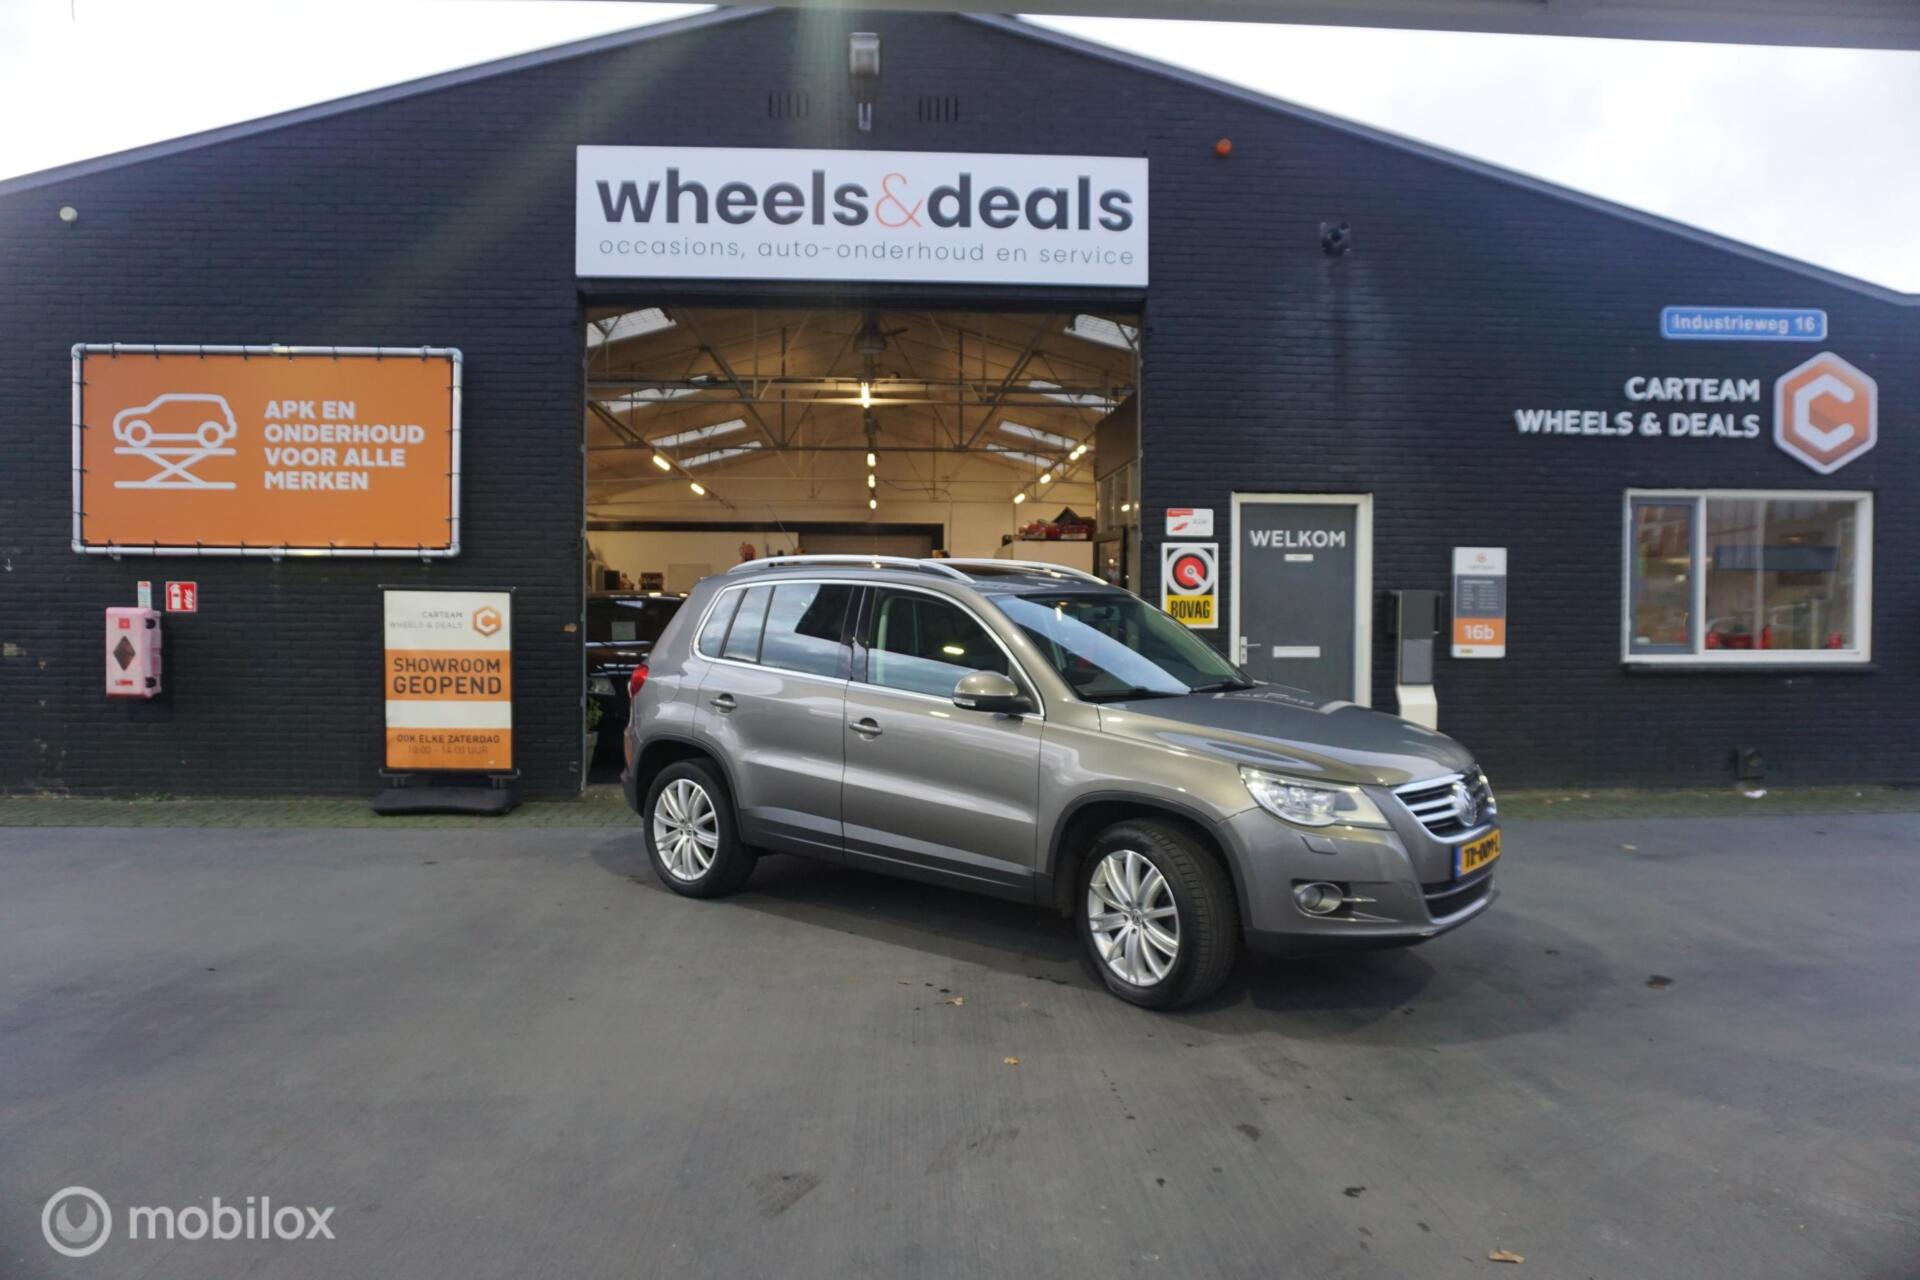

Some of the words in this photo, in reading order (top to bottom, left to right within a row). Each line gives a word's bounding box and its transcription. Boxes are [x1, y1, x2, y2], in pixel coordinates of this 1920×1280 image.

[599, 237, 746, 260] occasions,
[758, 239, 984, 262] auto-onderhoud
[997, 246, 1027, 263] en
[1039, 246, 1134, 266] service
[1674, 314, 1788, 334] Industrieweg
[1795, 317, 1815, 332] 16
[1624, 377, 1760, 402] CARTEAM
[264, 400, 315, 419] APK
[322, 400, 355, 419] EN
[1515, 409, 1633, 435] WHEELS
[1640, 413, 1662, 436] &
[1669, 413, 1760, 438] DEALS
[264, 424, 425, 443] ONDERHOUD
[264, 447, 337, 467] VOOR
[343, 448, 405, 467] ALLE
[264, 471, 369, 490] MERKEN
[1250, 530, 1346, 547] WELKOM
[1171, 600, 1210, 619] BOVAG
[1464, 624, 1494, 640] 16b
[393, 657, 500, 673] SHOWROOM
[393, 676, 502, 695] GEOPEND
[419, 734, 445, 744] ELKE
[447, 735, 500, 744] ZATERDAG
